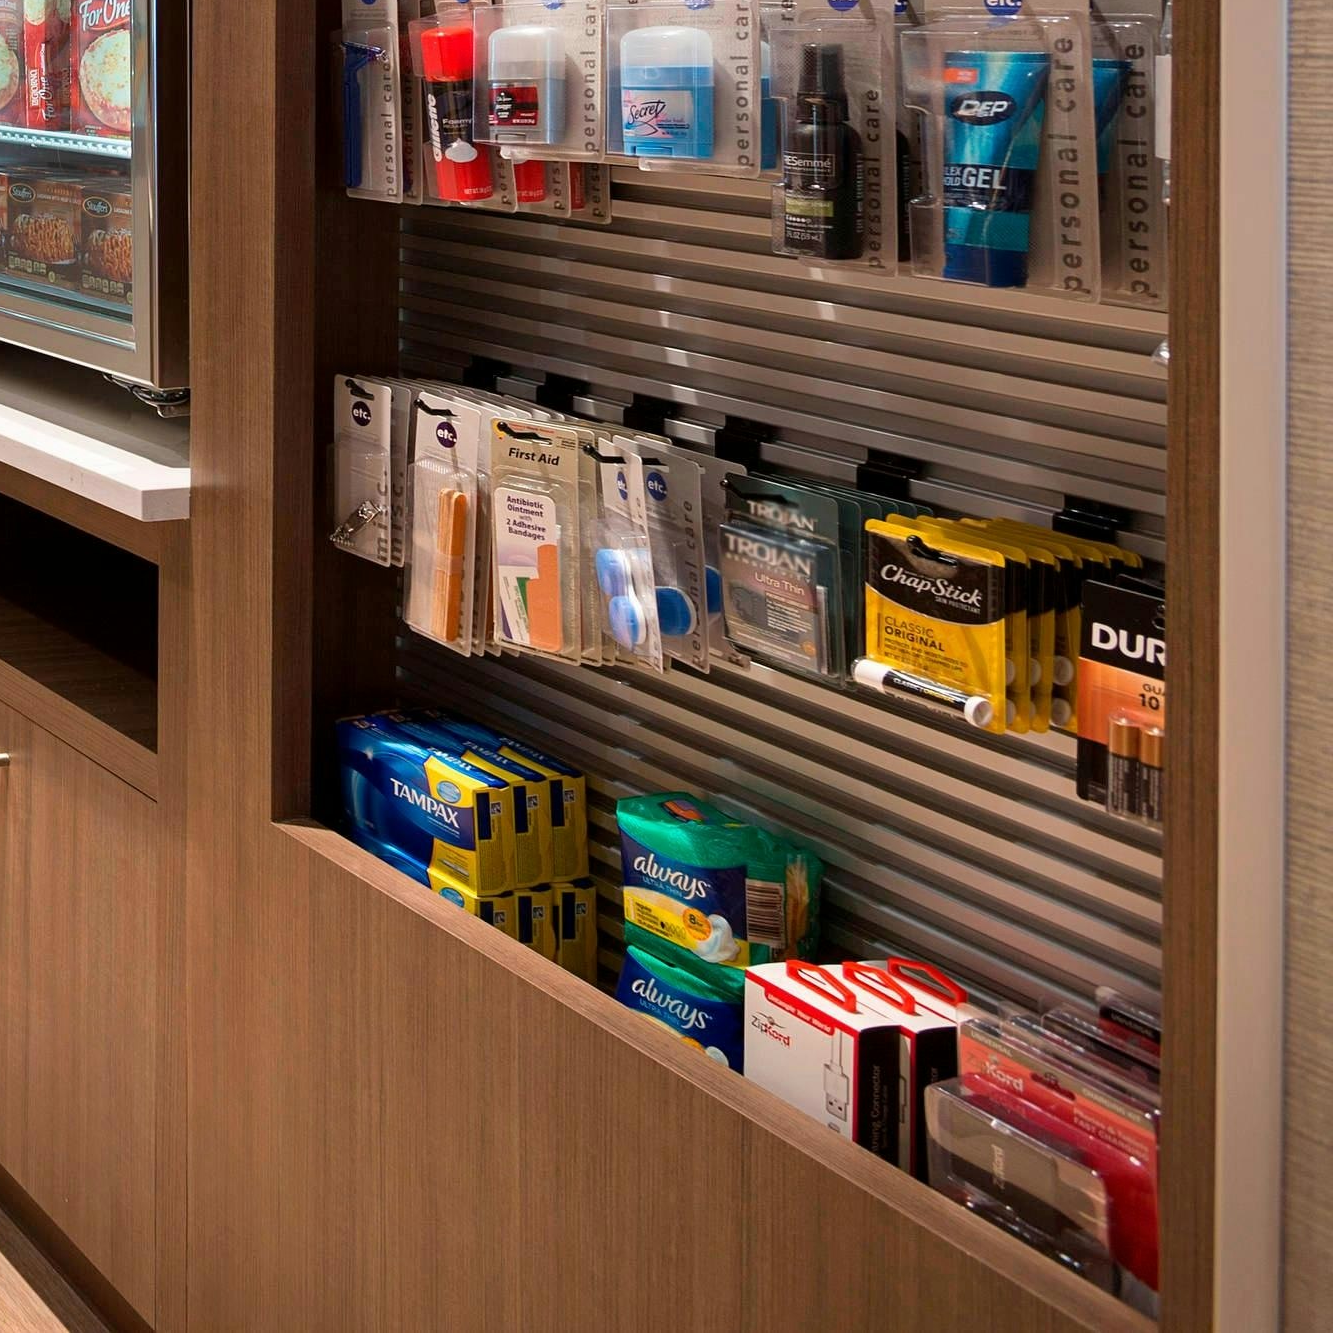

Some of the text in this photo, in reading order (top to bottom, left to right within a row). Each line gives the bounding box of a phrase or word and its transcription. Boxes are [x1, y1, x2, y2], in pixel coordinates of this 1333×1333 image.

[580, 51, 600, 153] personal
[627, 99, 666, 125] Secret
[730, 56, 755, 167] personal
[955, 97, 1009, 118] DEP
[381, 114, 398, 198] personal
[1047, 36, 1090, 294] personal care
[862, 89, 884, 269] personal care
[961, 167, 1007, 190] GEL
[1117, 43, 1158, 297] personal care
[352, 409, 371, 420] etc.
[437, 429, 458, 442] etc.
[508, 447, 560, 466] First Aid
[647, 479, 667, 495] etc.
[506, 496, 544, 510] Antibiotic
[507, 504, 544, 518] Ointment
[746, 499, 817, 532] TROJAN
[506, 518, 546, 533] 2 Adhesive
[508, 526, 545, 542] Bandages
[683, 500, 697, 550] care
[724, 532, 813, 577] TROJAN
[755, 572, 806, 596] Ultra Thin
[880, 563, 983, 607] ChapStick
[935, 596, 947, 604] SKIN
[884, 615, 934, 638] CLASSIC
[884, 626, 945, 652] ORIGINAL
[1139, 693, 1160, 710] 10
[390, 777, 460, 828] TAMPAX
[633, 853, 707, 900] always
[631, 978, 707, 1030] always
[751, 1014, 790, 1048] ZipKord
[812, 1017, 831, 1033] World
